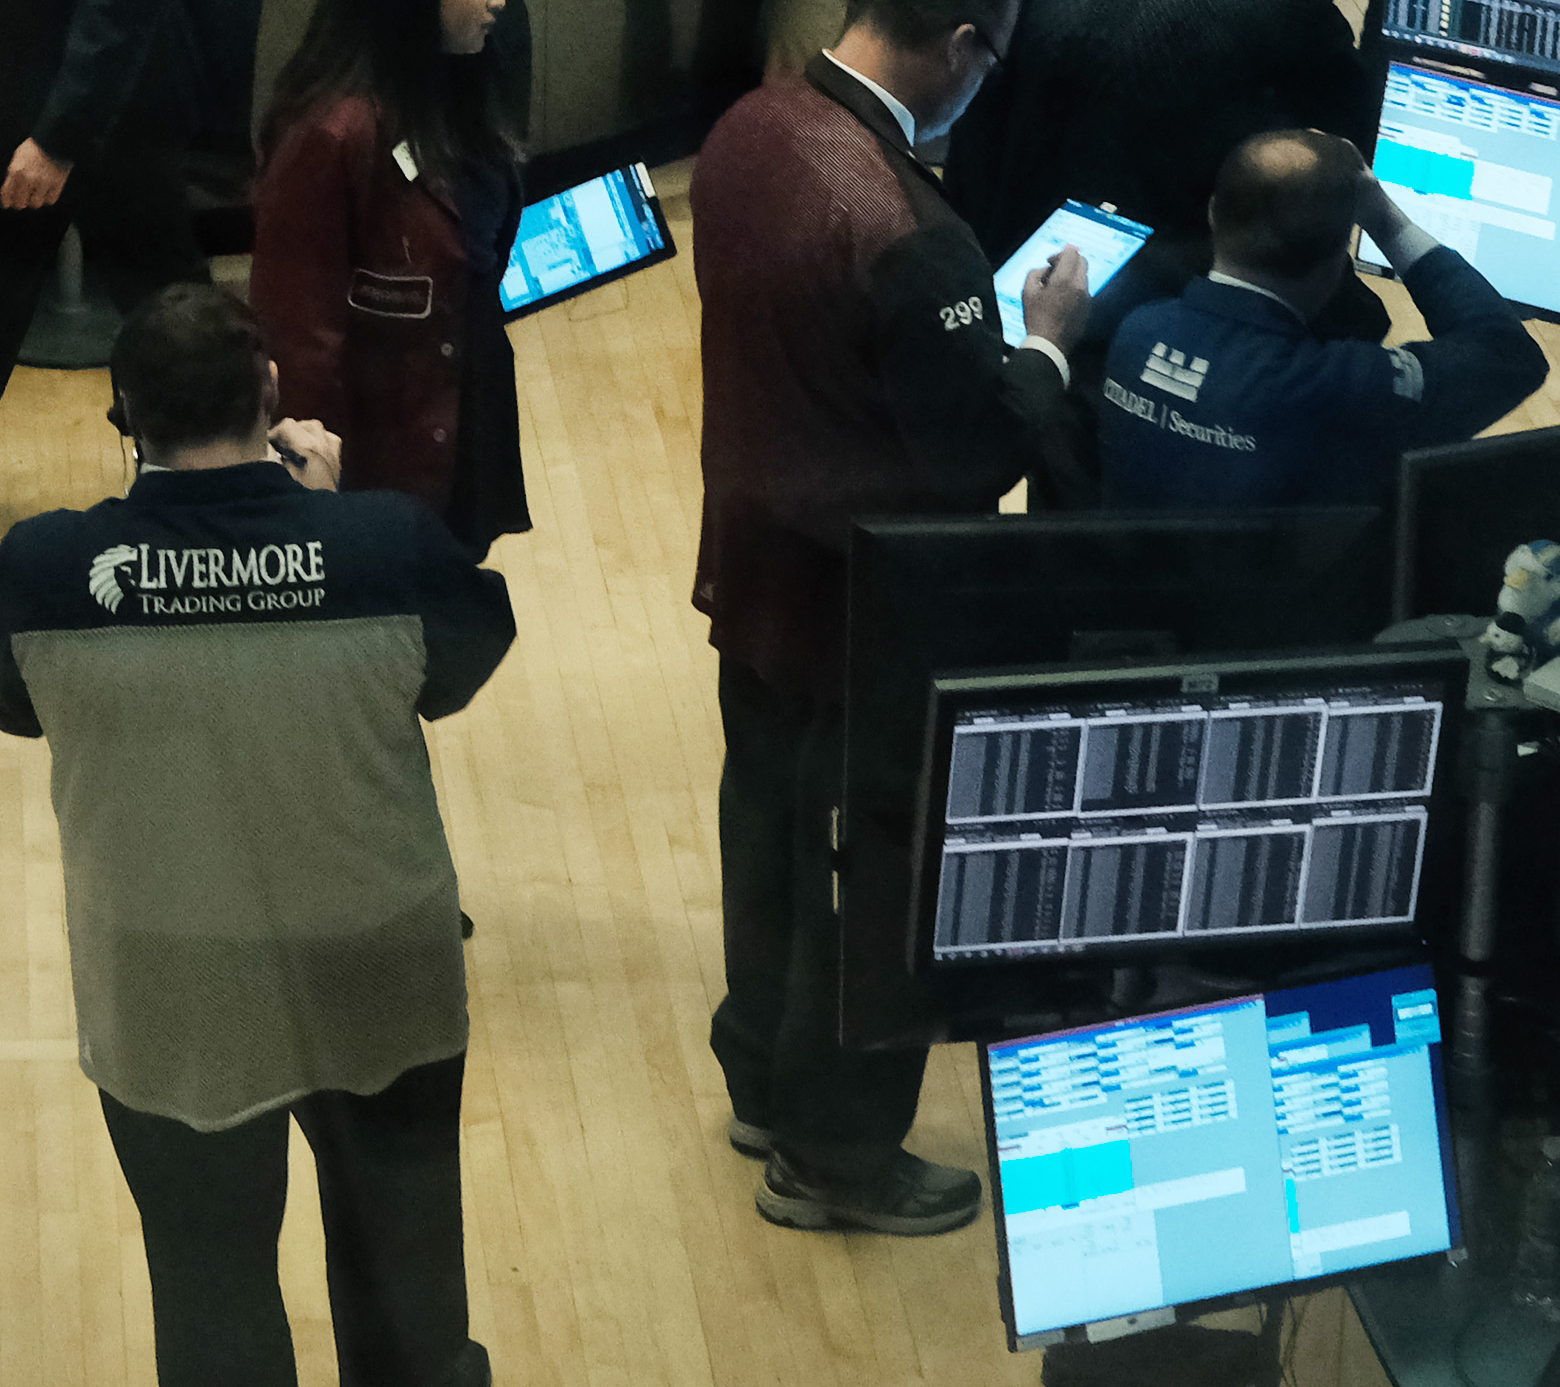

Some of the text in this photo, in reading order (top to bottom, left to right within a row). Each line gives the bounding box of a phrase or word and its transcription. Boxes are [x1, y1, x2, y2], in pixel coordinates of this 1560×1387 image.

[940, 295, 984, 331] 299
[1105, 385, 1257, 454] CITADEL Securities
[138, 540, 325, 590] LIVERMORE
[137, 585, 325, 616] TRADING GROUP
